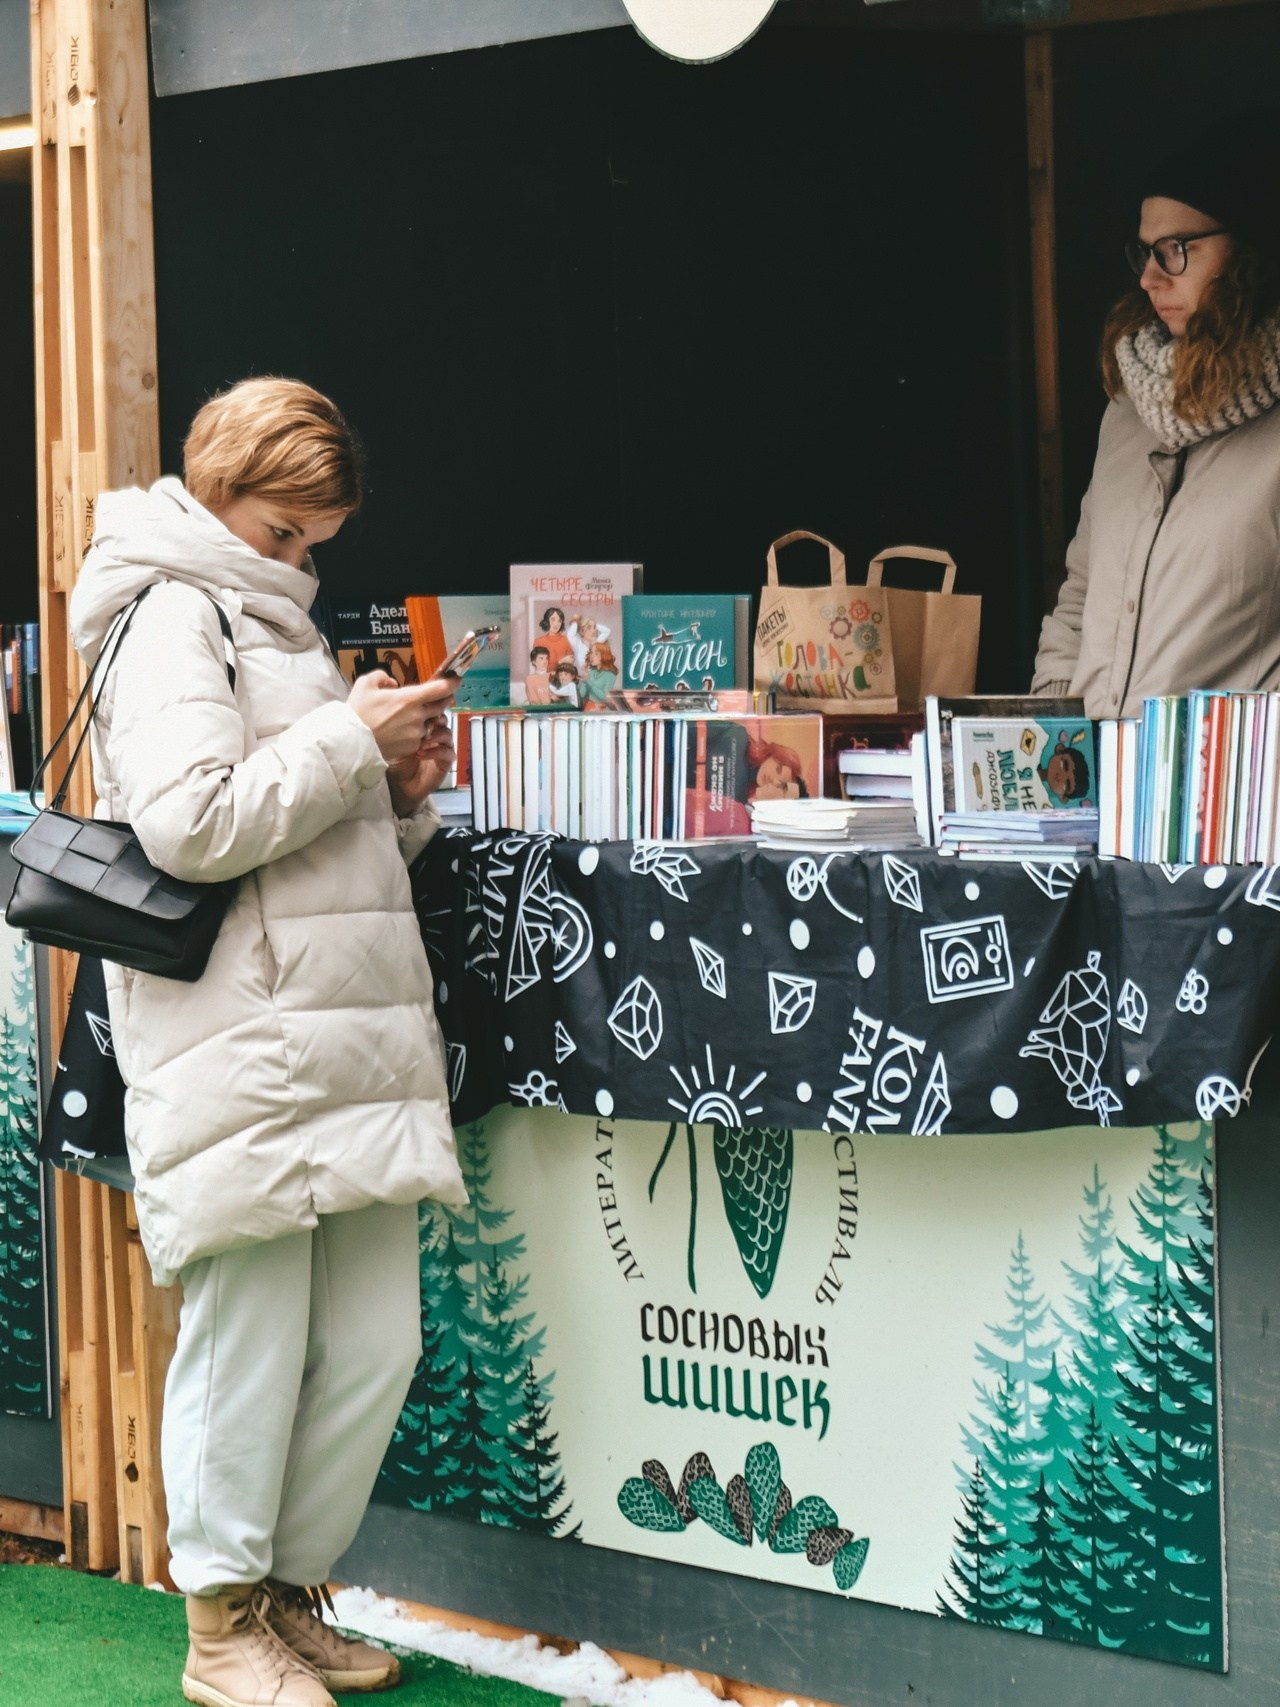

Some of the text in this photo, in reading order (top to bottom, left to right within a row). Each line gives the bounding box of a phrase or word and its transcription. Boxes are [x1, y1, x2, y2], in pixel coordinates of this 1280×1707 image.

[530, 576, 583, 592] ЧЕТЫРЕ
[561, 592, 615, 607] СЕСТРЫ
[368, 603, 408, 619] Адел
[757, 605, 787, 641] ПАКЕТЫ
[1017, 766, 1038, 811] Я НЕ
[822, 1006, 883, 1135] FANT
[595, 1118, 859, 1305] ЛИТЕРАТ СТИВАЛЬ
